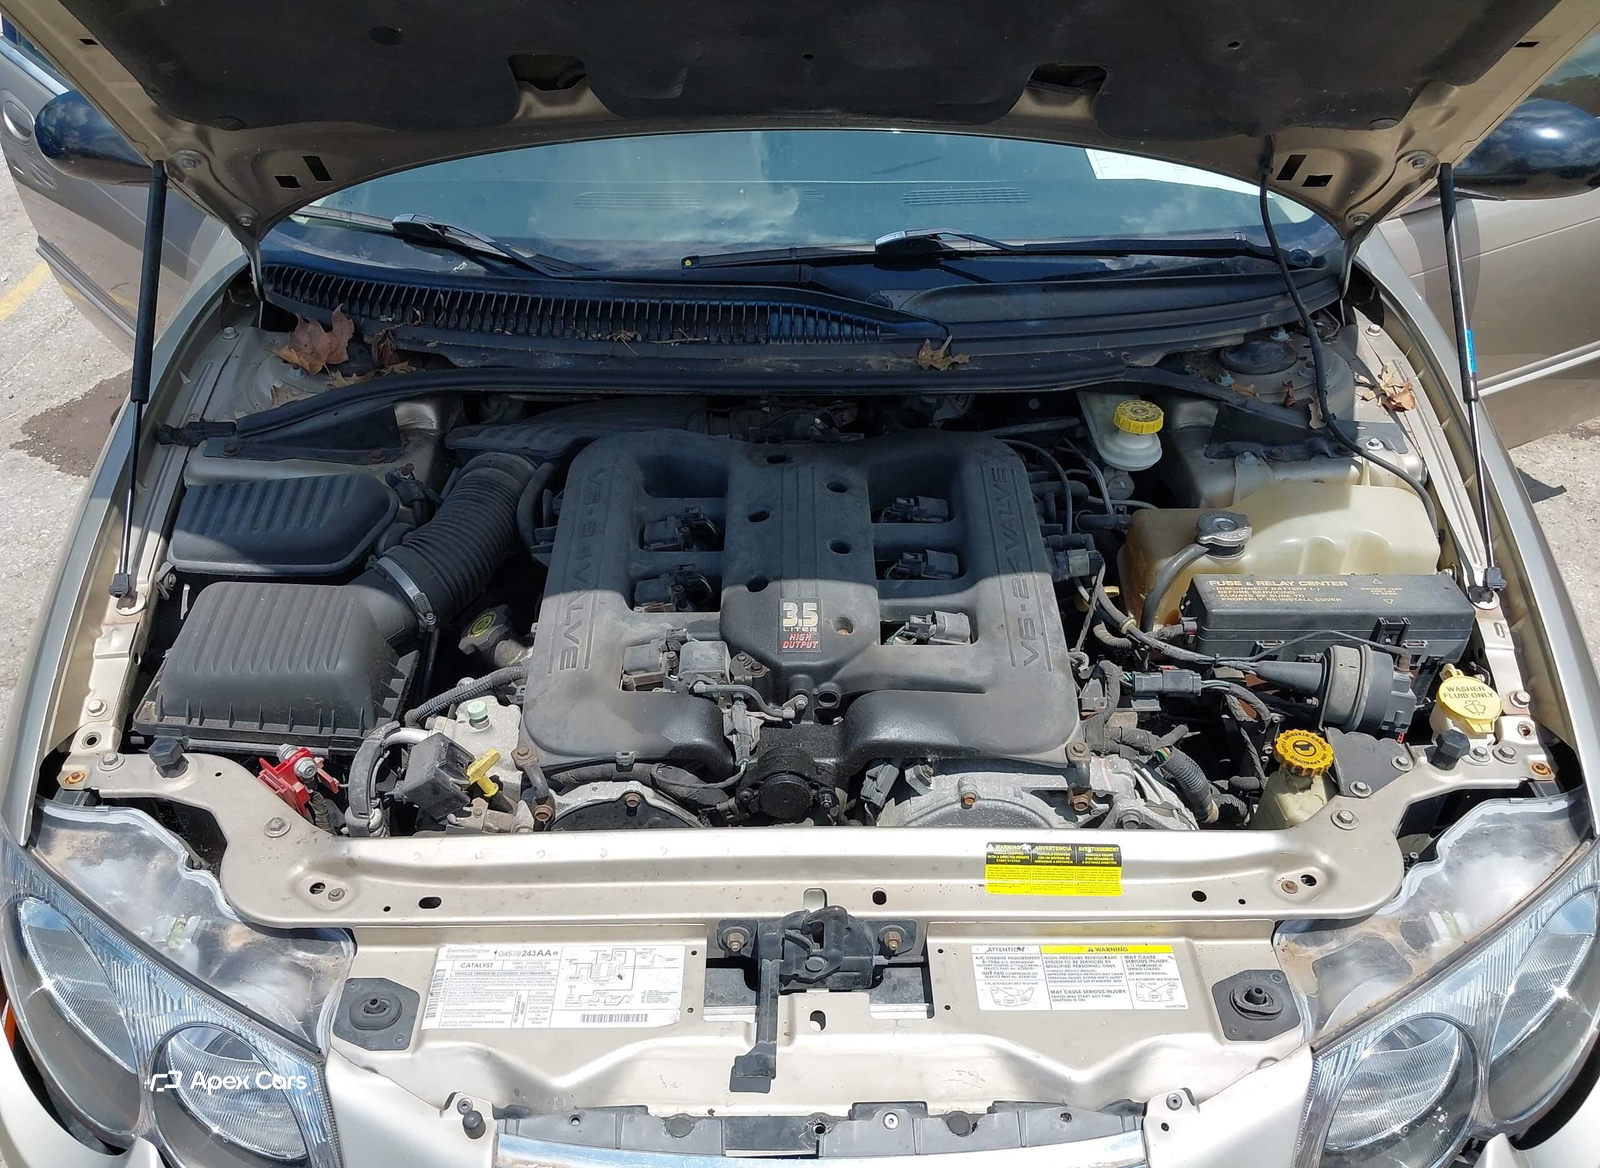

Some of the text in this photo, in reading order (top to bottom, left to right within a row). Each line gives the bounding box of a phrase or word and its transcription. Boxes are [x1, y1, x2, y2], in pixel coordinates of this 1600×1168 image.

[992, 467, 1020, 552] VALVE
[559, 562, 592, 672] VALVE
[782, 602, 818, 627] 3.5
[782, 640, 818, 649] OUTPUT
